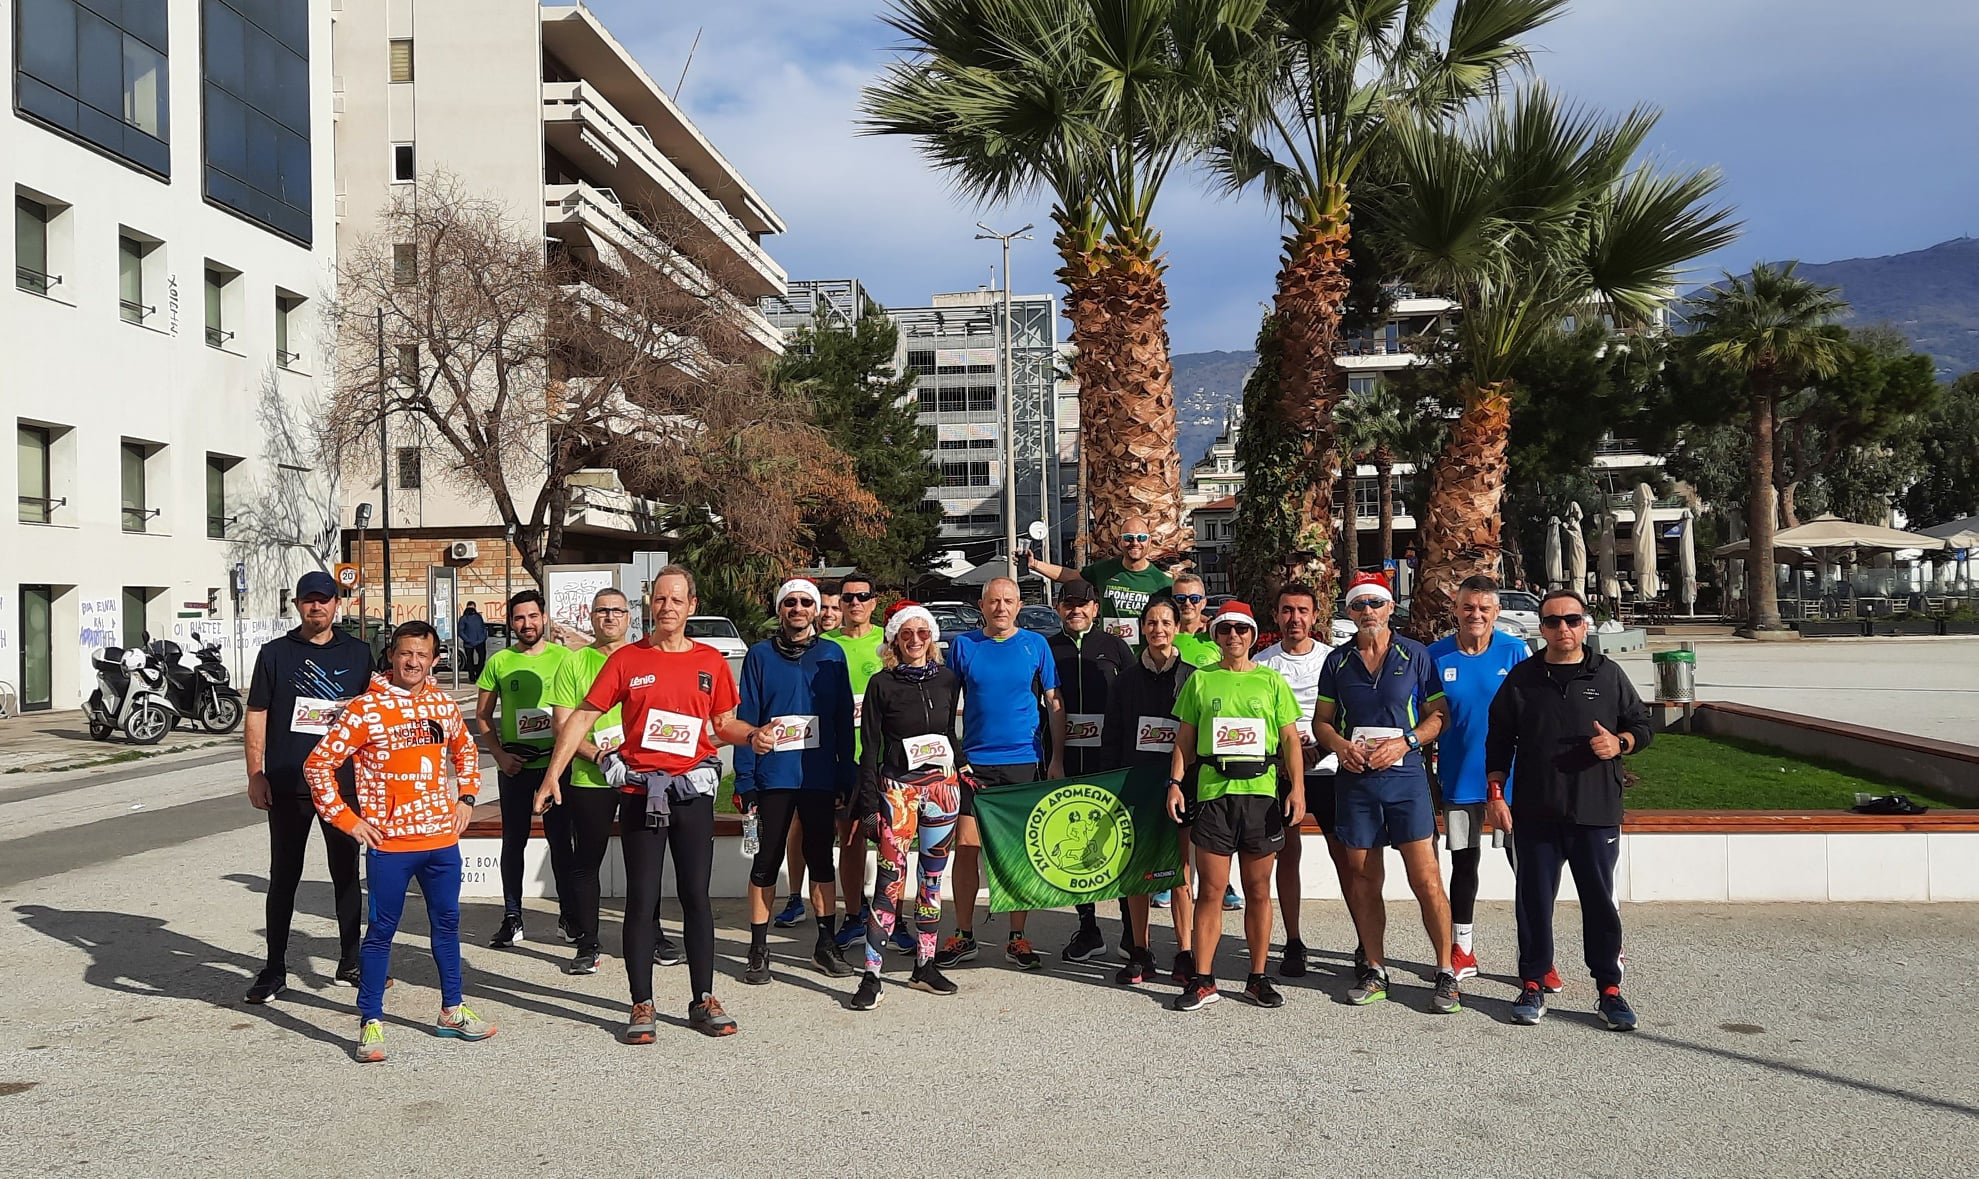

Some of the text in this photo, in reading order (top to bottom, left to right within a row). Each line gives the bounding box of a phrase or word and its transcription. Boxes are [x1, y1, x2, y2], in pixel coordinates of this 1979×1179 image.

[342, 572, 353, 580] 20
[417, 703, 455, 718] STOP
[1028, 787, 1132, 872] ΣΥΛΛΟΓΟΣ ΔΡΟΜΕΩΝ ΥΓΕΙΑΣ
[461, 872, 486, 883] 2021
[1069, 868, 1113, 889] ΒΟΛΟΥ
